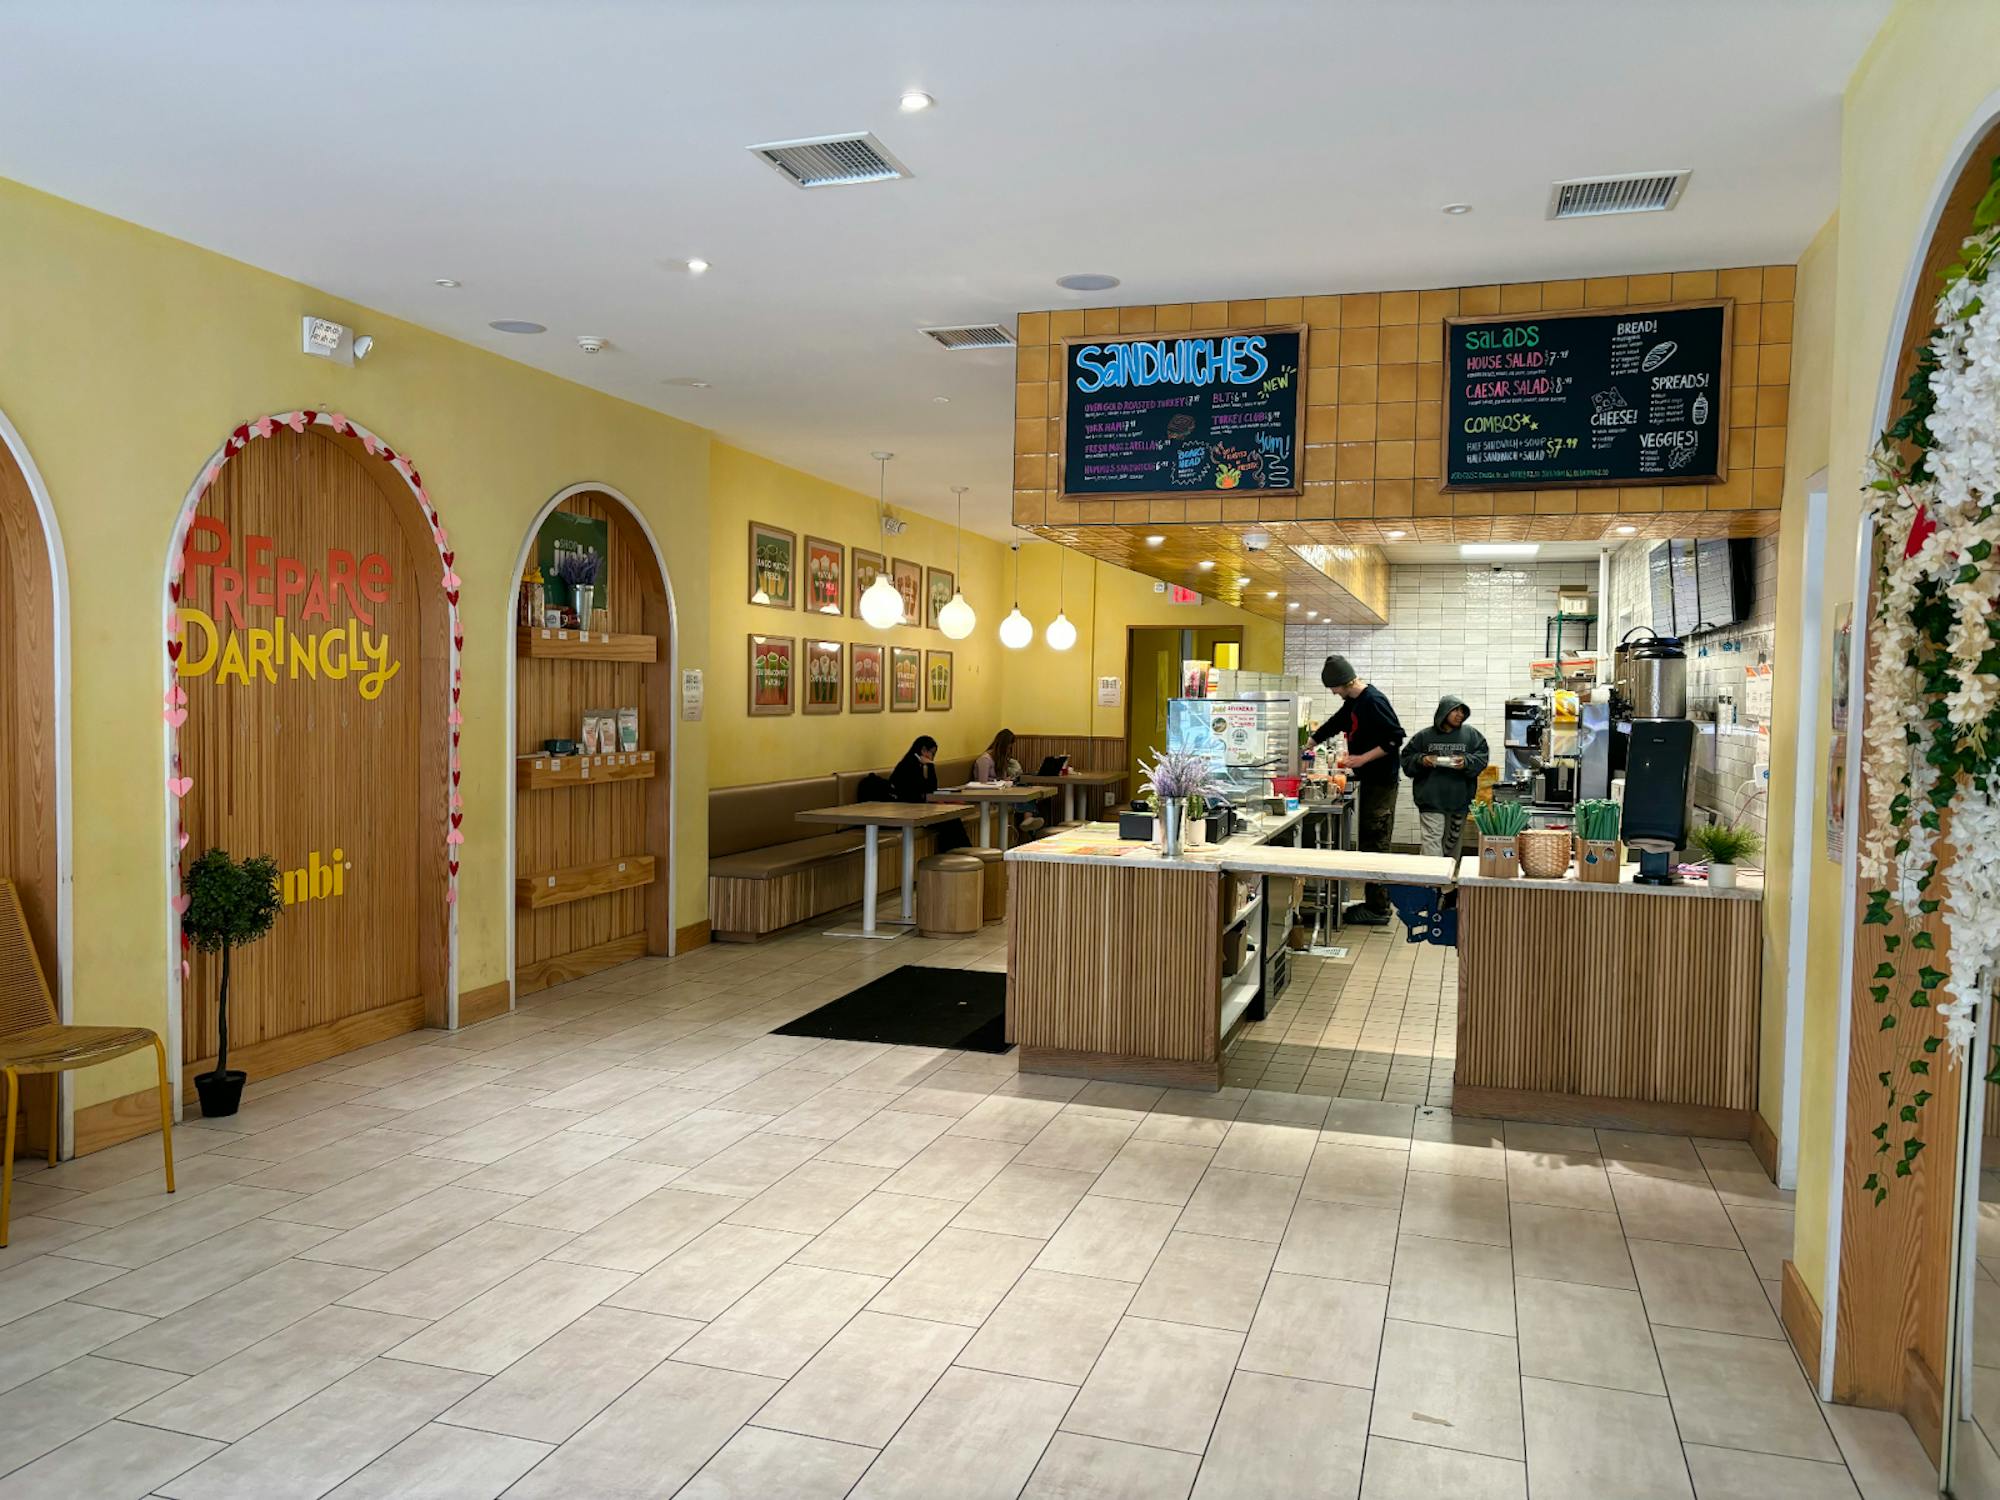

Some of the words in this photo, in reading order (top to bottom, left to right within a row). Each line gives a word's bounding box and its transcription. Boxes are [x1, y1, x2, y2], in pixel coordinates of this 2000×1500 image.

[1617, 320, 1657, 335] BREAD!
[1467, 353, 1502, 370] HOUSE
[1505, 351, 1544, 368] SALAD
[1262, 372, 1289, 393] NEW
[1465, 380, 1511, 399] CAESAR
[1513, 376, 1549, 396] SALAD
[1650, 373, 1709, 391] SPREADS!
[1464, 413, 1521, 434] COMBOS
[1590, 409, 1638, 426] CHEESE!
[1467, 442, 1482, 452] HALF
[1483, 439, 1518, 451] SANDWICH
[1639, 430, 1698, 448] VEGGIES!
[1467, 452, 1482, 464] HALF
[1483, 451, 1518, 463] SANDWICH
[273, 848, 344, 905] nbi
